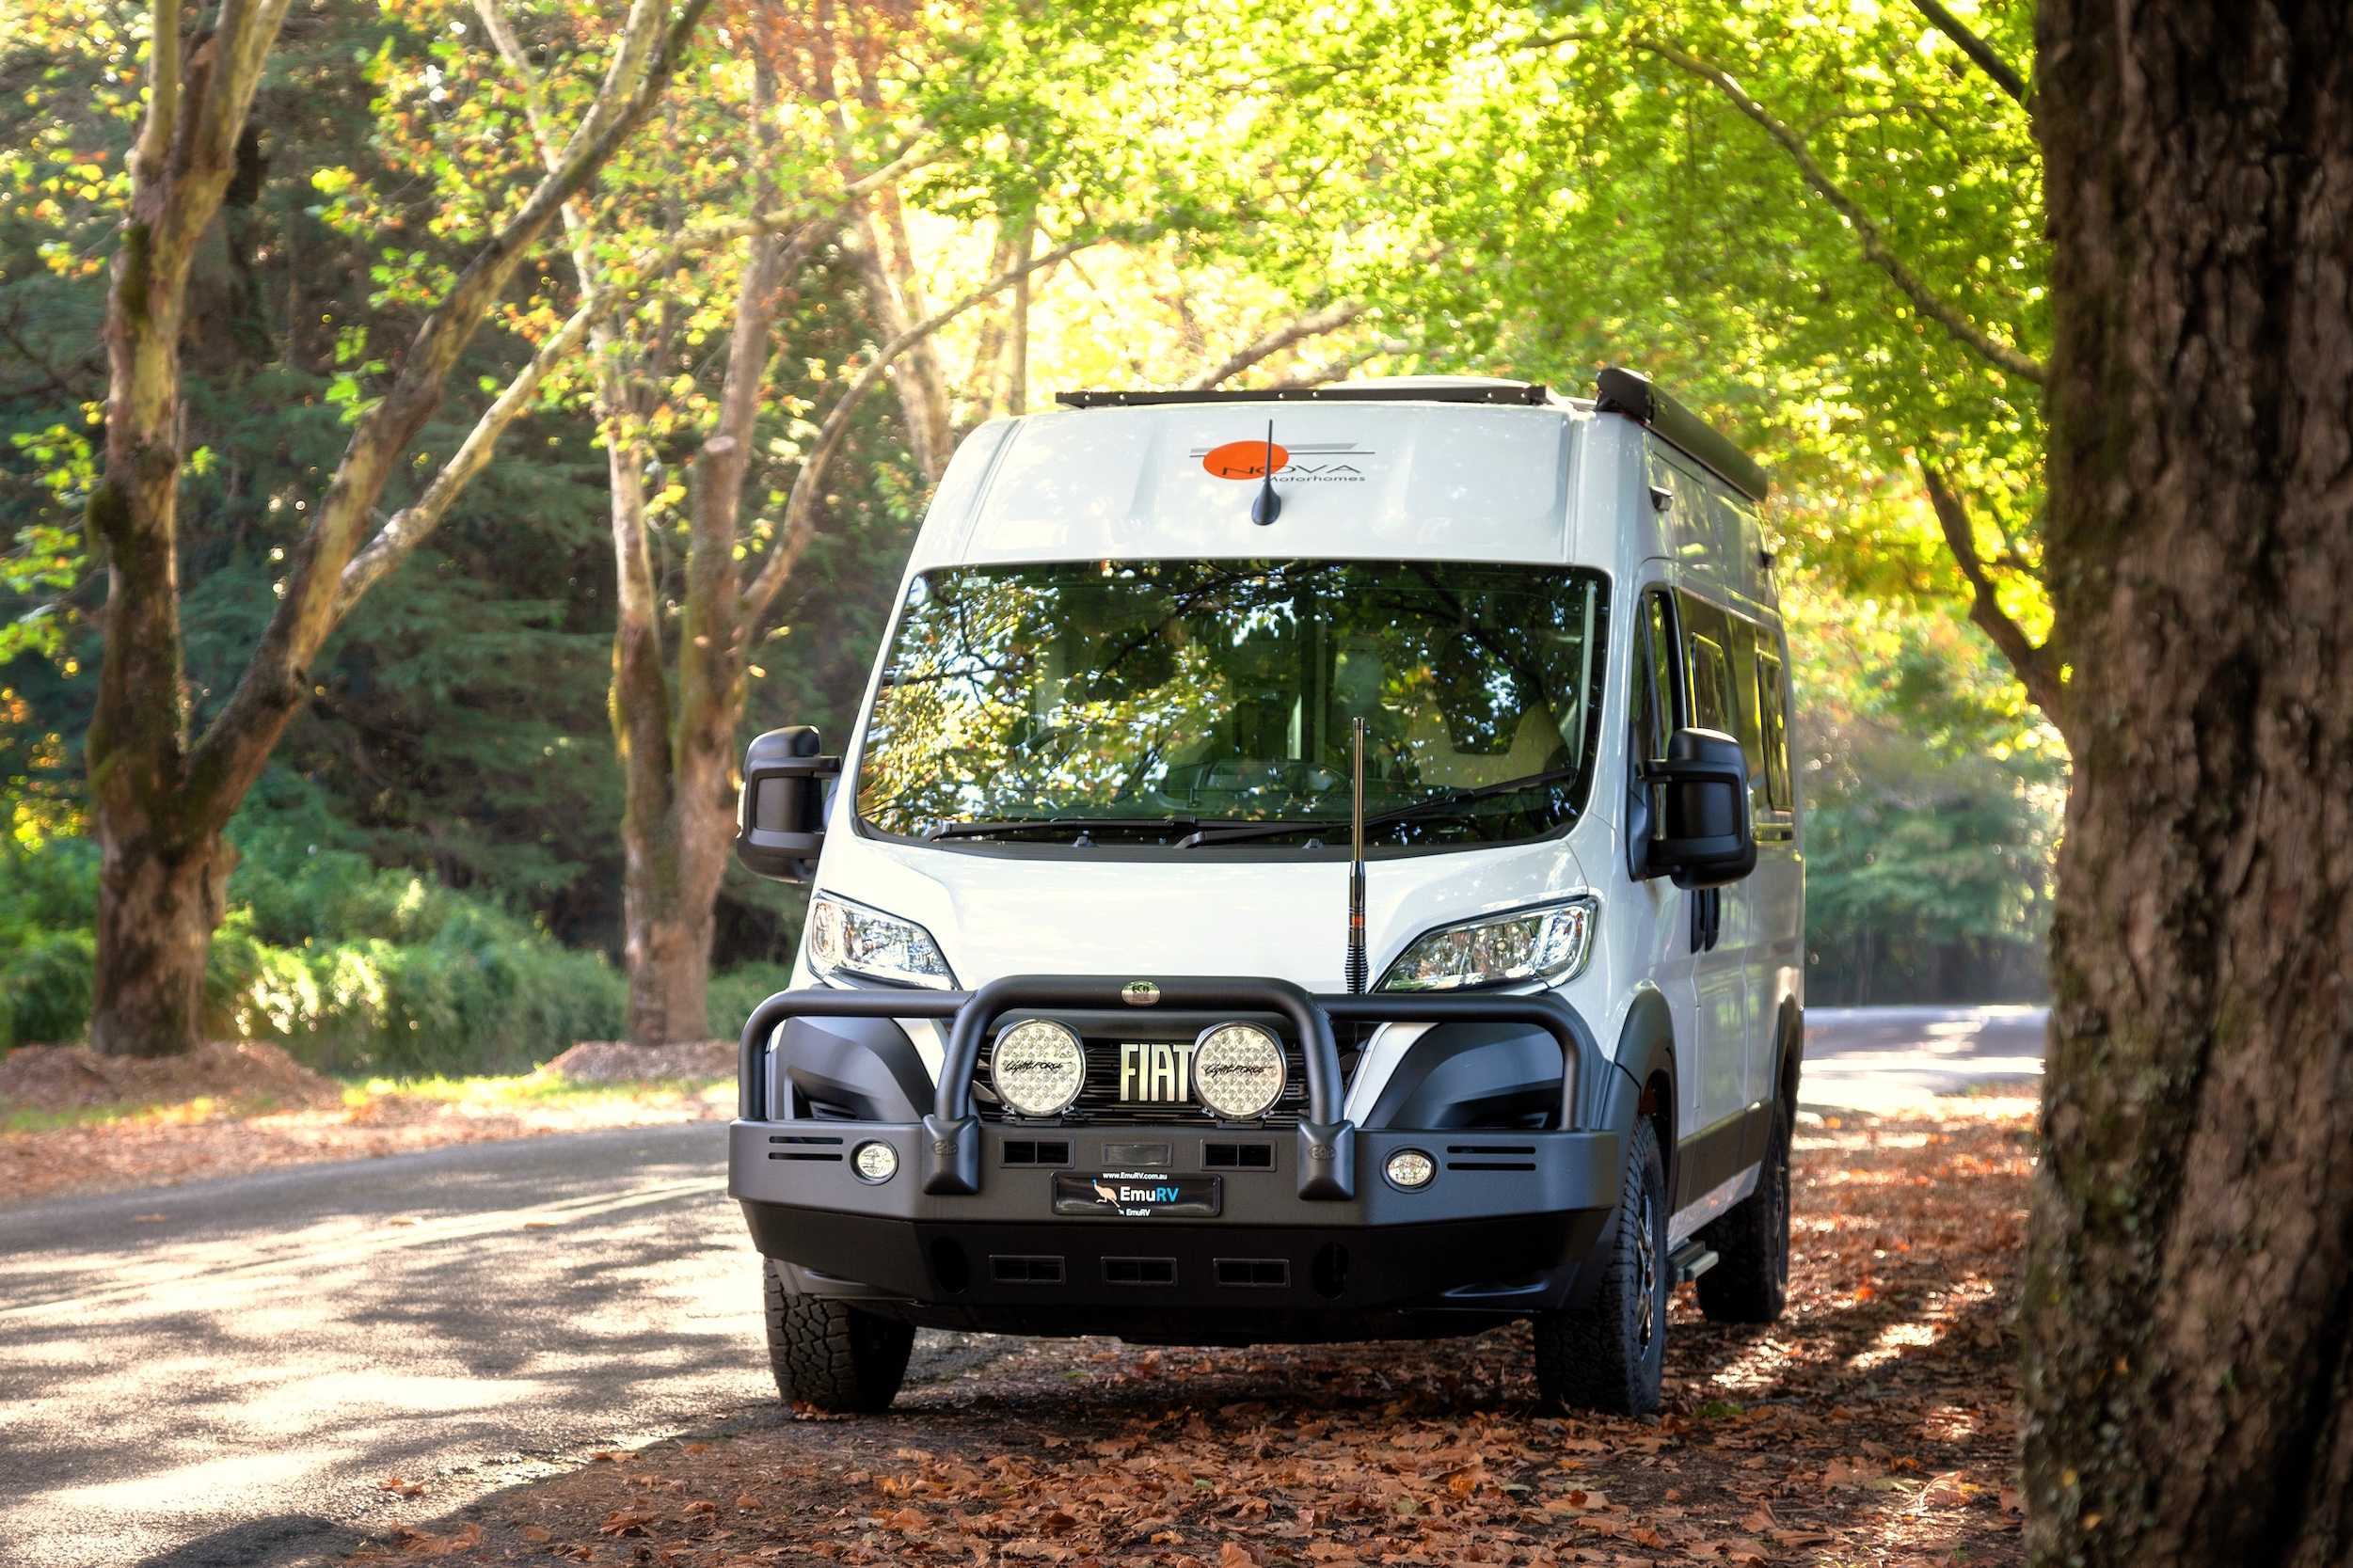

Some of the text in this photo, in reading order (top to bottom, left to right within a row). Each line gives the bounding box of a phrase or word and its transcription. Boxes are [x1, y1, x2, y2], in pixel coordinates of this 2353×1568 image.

[1222, 464, 1361, 476] NOVA
[1120, 1043, 1193, 1102] FIAT
[1102, 1172, 1168, 1180] www.EmuRV.com.au
[1120, 1186, 1180, 1203] EmuRV
[1125, 1208, 1152, 1217] EmuRV
